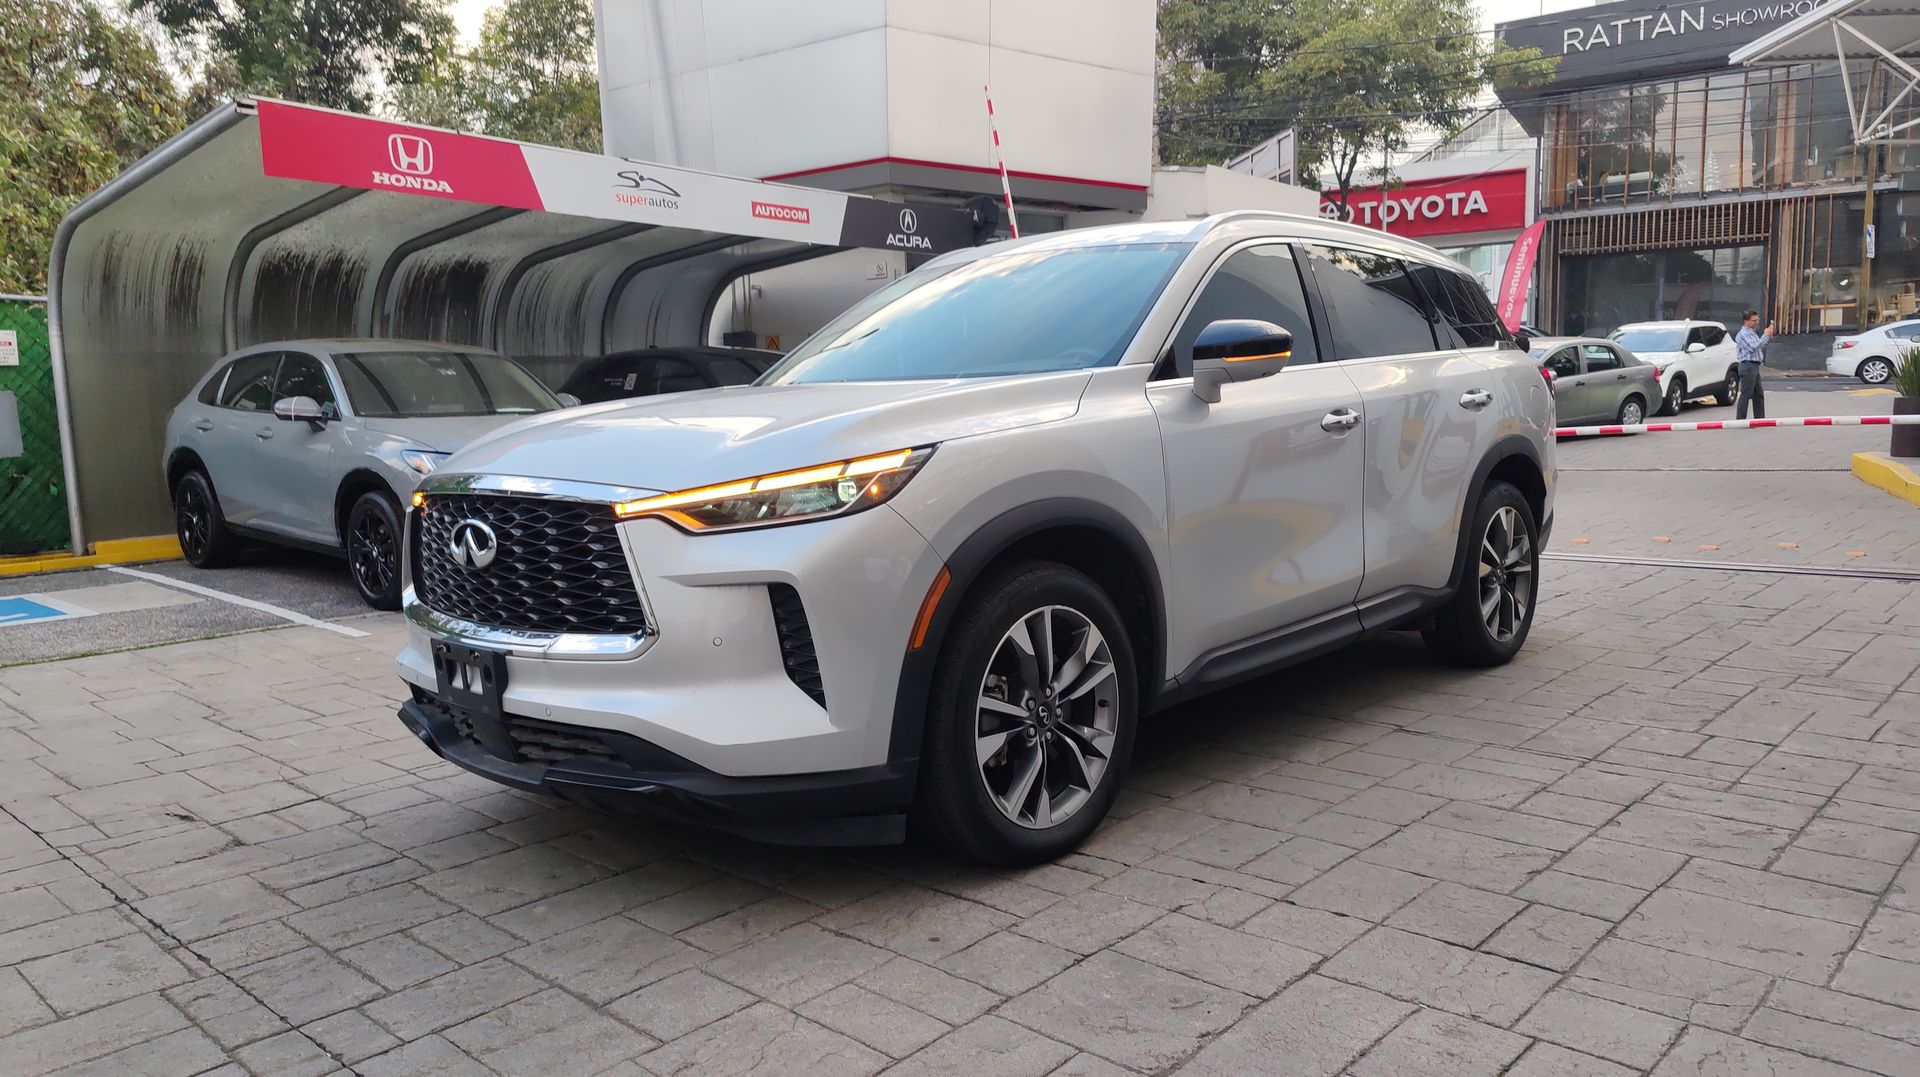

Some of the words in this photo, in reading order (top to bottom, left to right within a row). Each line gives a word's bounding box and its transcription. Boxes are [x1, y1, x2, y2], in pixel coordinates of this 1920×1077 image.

[1563, 6, 1705, 54] RATTAN
[372, 171, 454, 194] HONDA
[616, 193, 680, 210] superautos
[755, 204, 808, 221] AUTOCOM
[1358, 190, 1489, 225] TOYOTA
[886, 233, 933, 249] ACURA
[1504, 236, 1533, 318] Seminuevos
